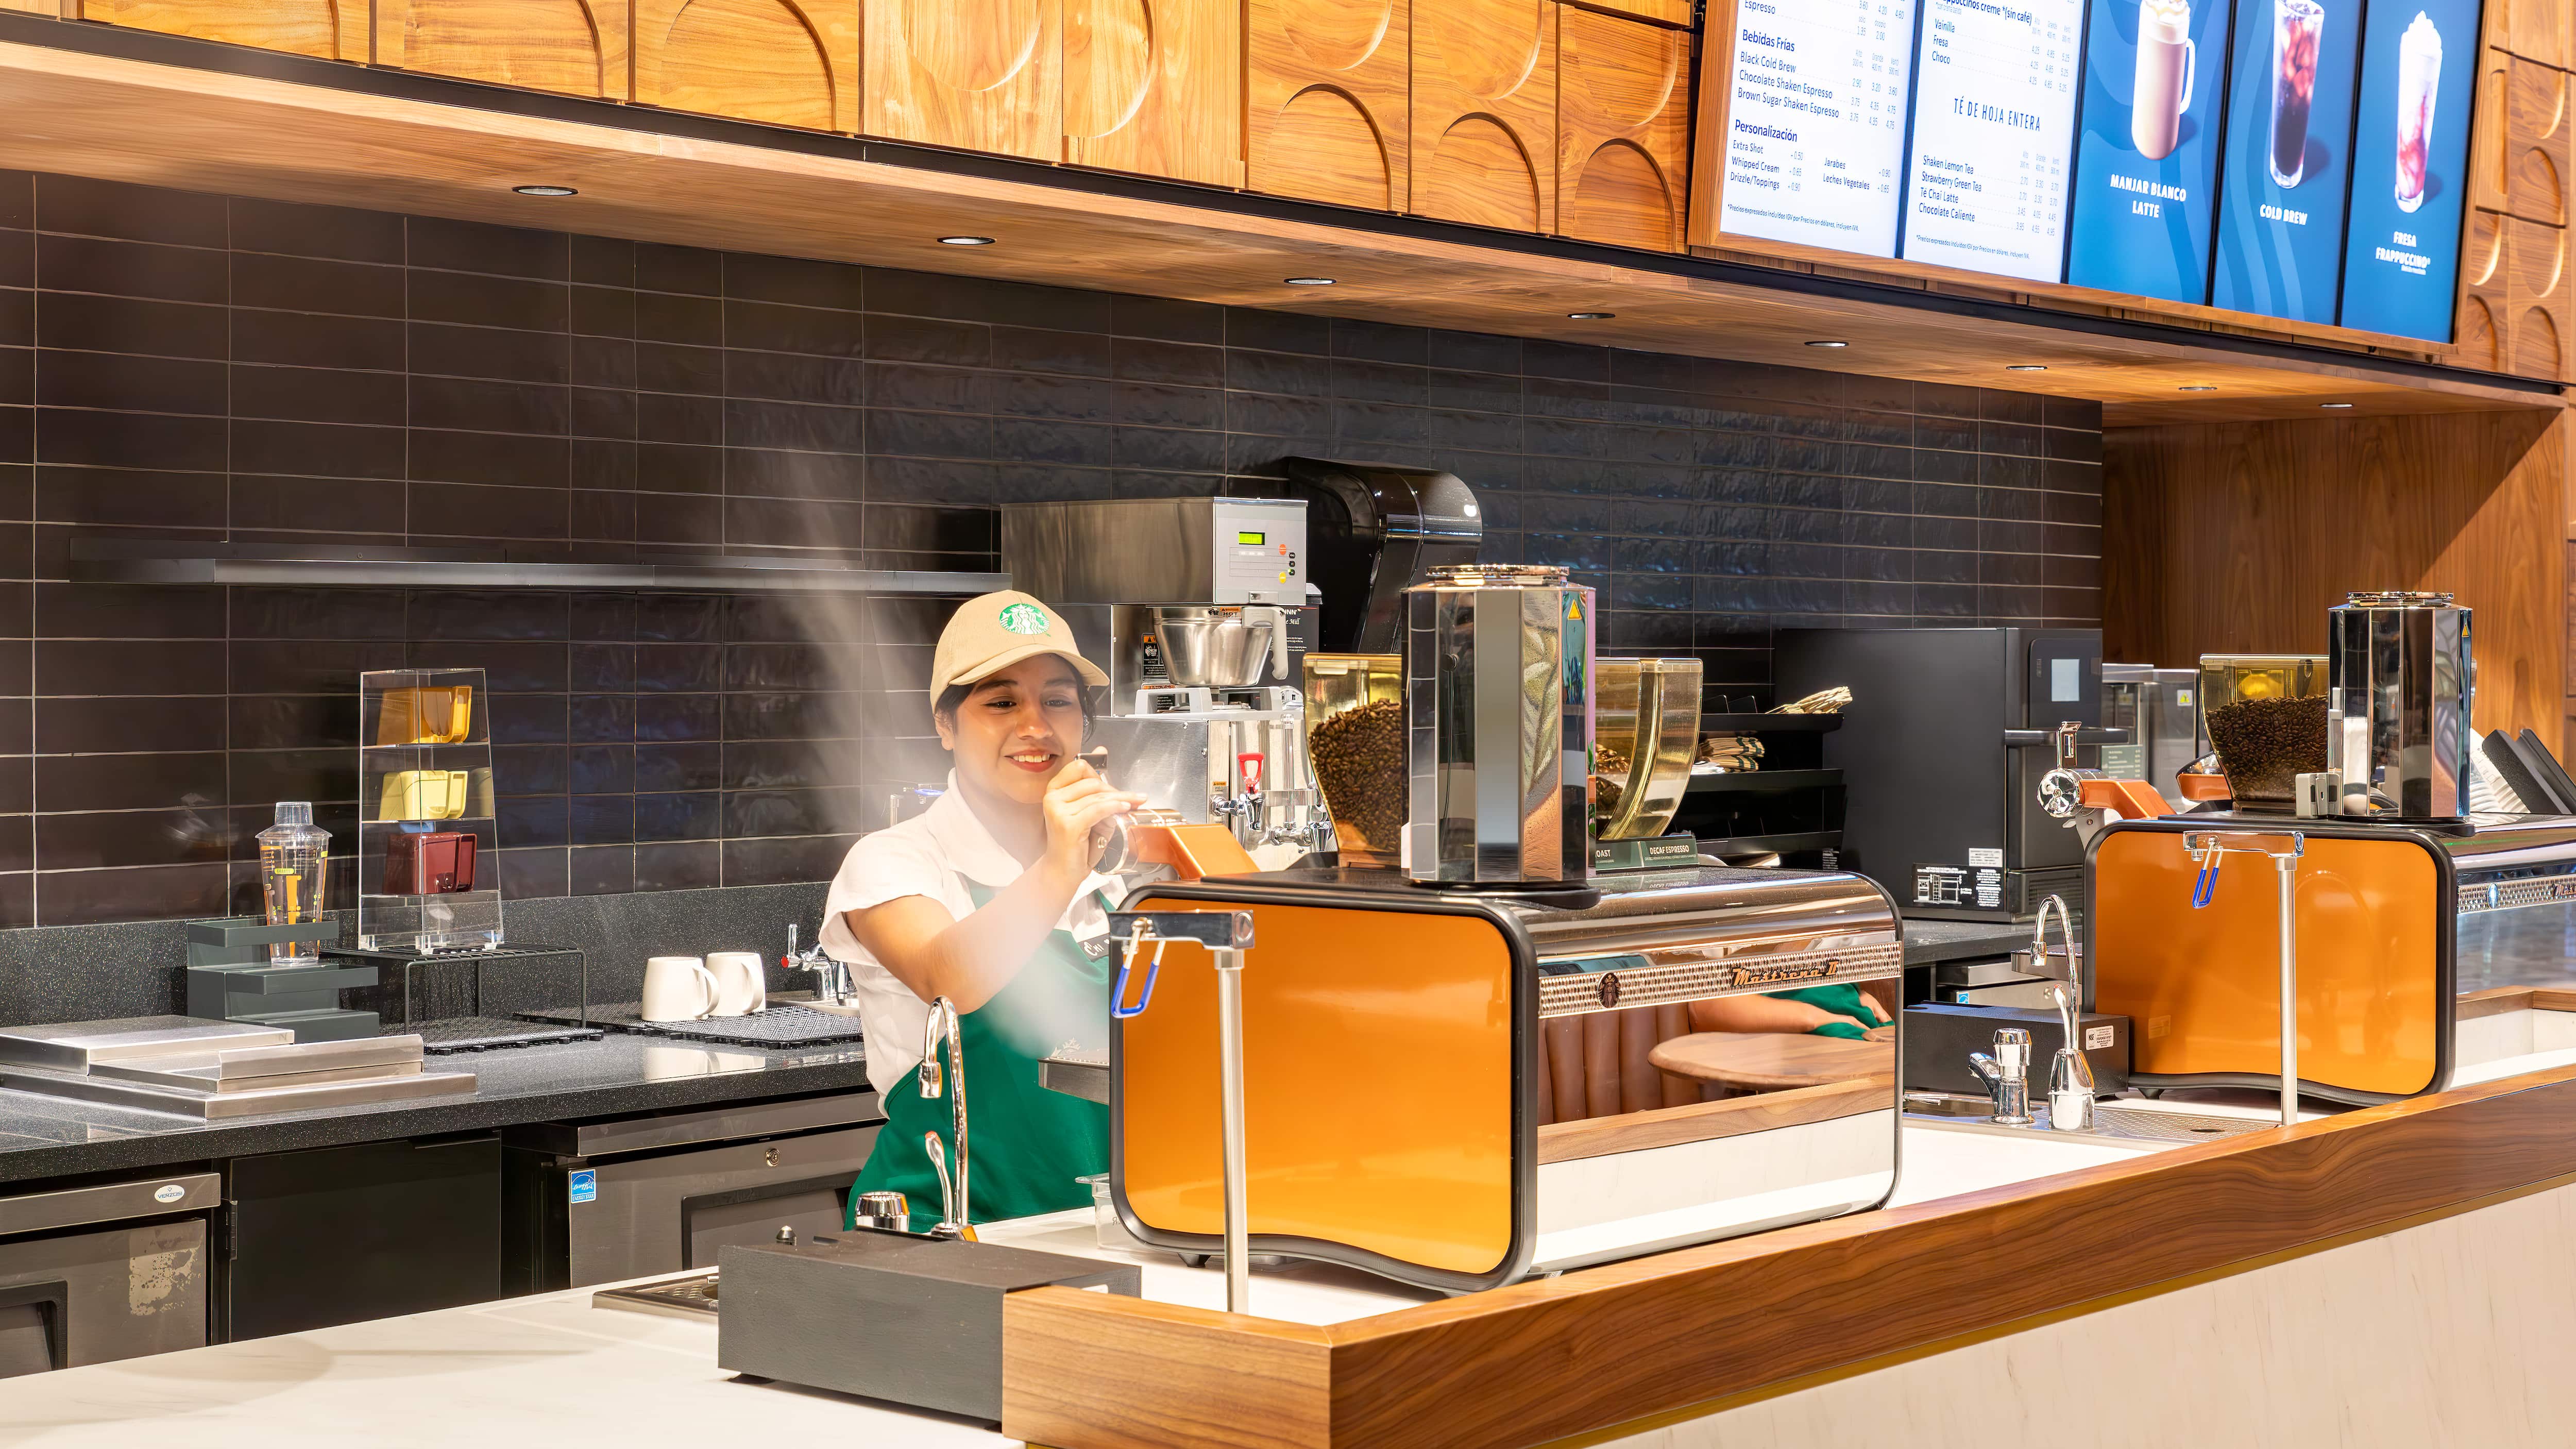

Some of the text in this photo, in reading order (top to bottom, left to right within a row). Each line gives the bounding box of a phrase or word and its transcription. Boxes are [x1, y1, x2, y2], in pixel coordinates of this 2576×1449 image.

[1745, 0, 1775, 14] Espresso
[1878, 5, 1887, 15] 4.20
[1895, 10, 1904, 19] 4.60
[1981, 4, 2001, 15] creme
[2017, 11, 2032, 26] café)
[1935, 18, 1955, 33] Vainilla
[1743, 29, 1795, 52] Bebidas Frías
[1934, 35, 1948, 47] Fresa
[1932, 51, 1951, 64] Choco
[1741, 52, 1759, 65] Black
[1761, 56, 1777, 69] Cold
[1779, 60, 1796, 73] Brew
[1853, 78, 1861, 88] 2.90
[1740, 70, 1775, 87] Chocolate
[1777, 77, 1801, 92] Shaken
[1803, 83, 1833, 98] Espresso
[1888, 105, 1896, 114] 4.75
[1738, 87, 1760, 102] Brown
[1762, 92, 1782, 107] Sugar
[1784, 97, 1808, 111] Shaken
[1810, 103, 1839, 117] Espresso
[1886, 120, 1894, 129] 4.75
[1954, 95, 2040, 131] TÉ DE HOJA ENTERA
[1735, 119, 1797, 142] Personalización
[1733, 140, 1748, 150] Extra
[1750, 143, 1763, 154] Shot
[1732, 156, 1759, 170] Whipped
[1760, 162, 1780, 173] Cream
[1824, 157, 1846, 169] Jarabes
[1923, 155, 1943, 169] Shaken
[1945, 159, 1963, 172] Lemon
[1965, 163, 1973, 174] Tea
[1731, 172, 1780, 190] Drizzle/Toppings
[1823, 173, 1842, 184] Leches
[1843, 177, 1870, 190] Vegetales
[1922, 171, 1953, 189] Strawberry
[1954, 178, 1971, 190] Green
[1973, 181, 1981, 192] Tea
[2110, 174, 2187, 202] MANJAR BLANCO
[1920, 187, 1927, 197] Té
[1929, 189, 1942, 200] Chai
[1943, 192, 1959, 203] Latte
[1919, 203, 1949, 217] Chocolate
[1951, 208, 1975, 222] Caliente
[2132, 200, 2159, 218] LATTE
[2260, 204, 2308, 225] COLD BREW
[1744, 208, 1767, 216] expresados
[1801, 216, 1815, 225] Precios
[1836, 222, 1852, 231] incluyen
[2393, 231, 2416, 247] FRESA
[1596, 849, 1611, 858] OAST
[1650, 845, 1689, 855] DECAF ESPRESSO
[1733, 968, 1822, 986] Mastrena
